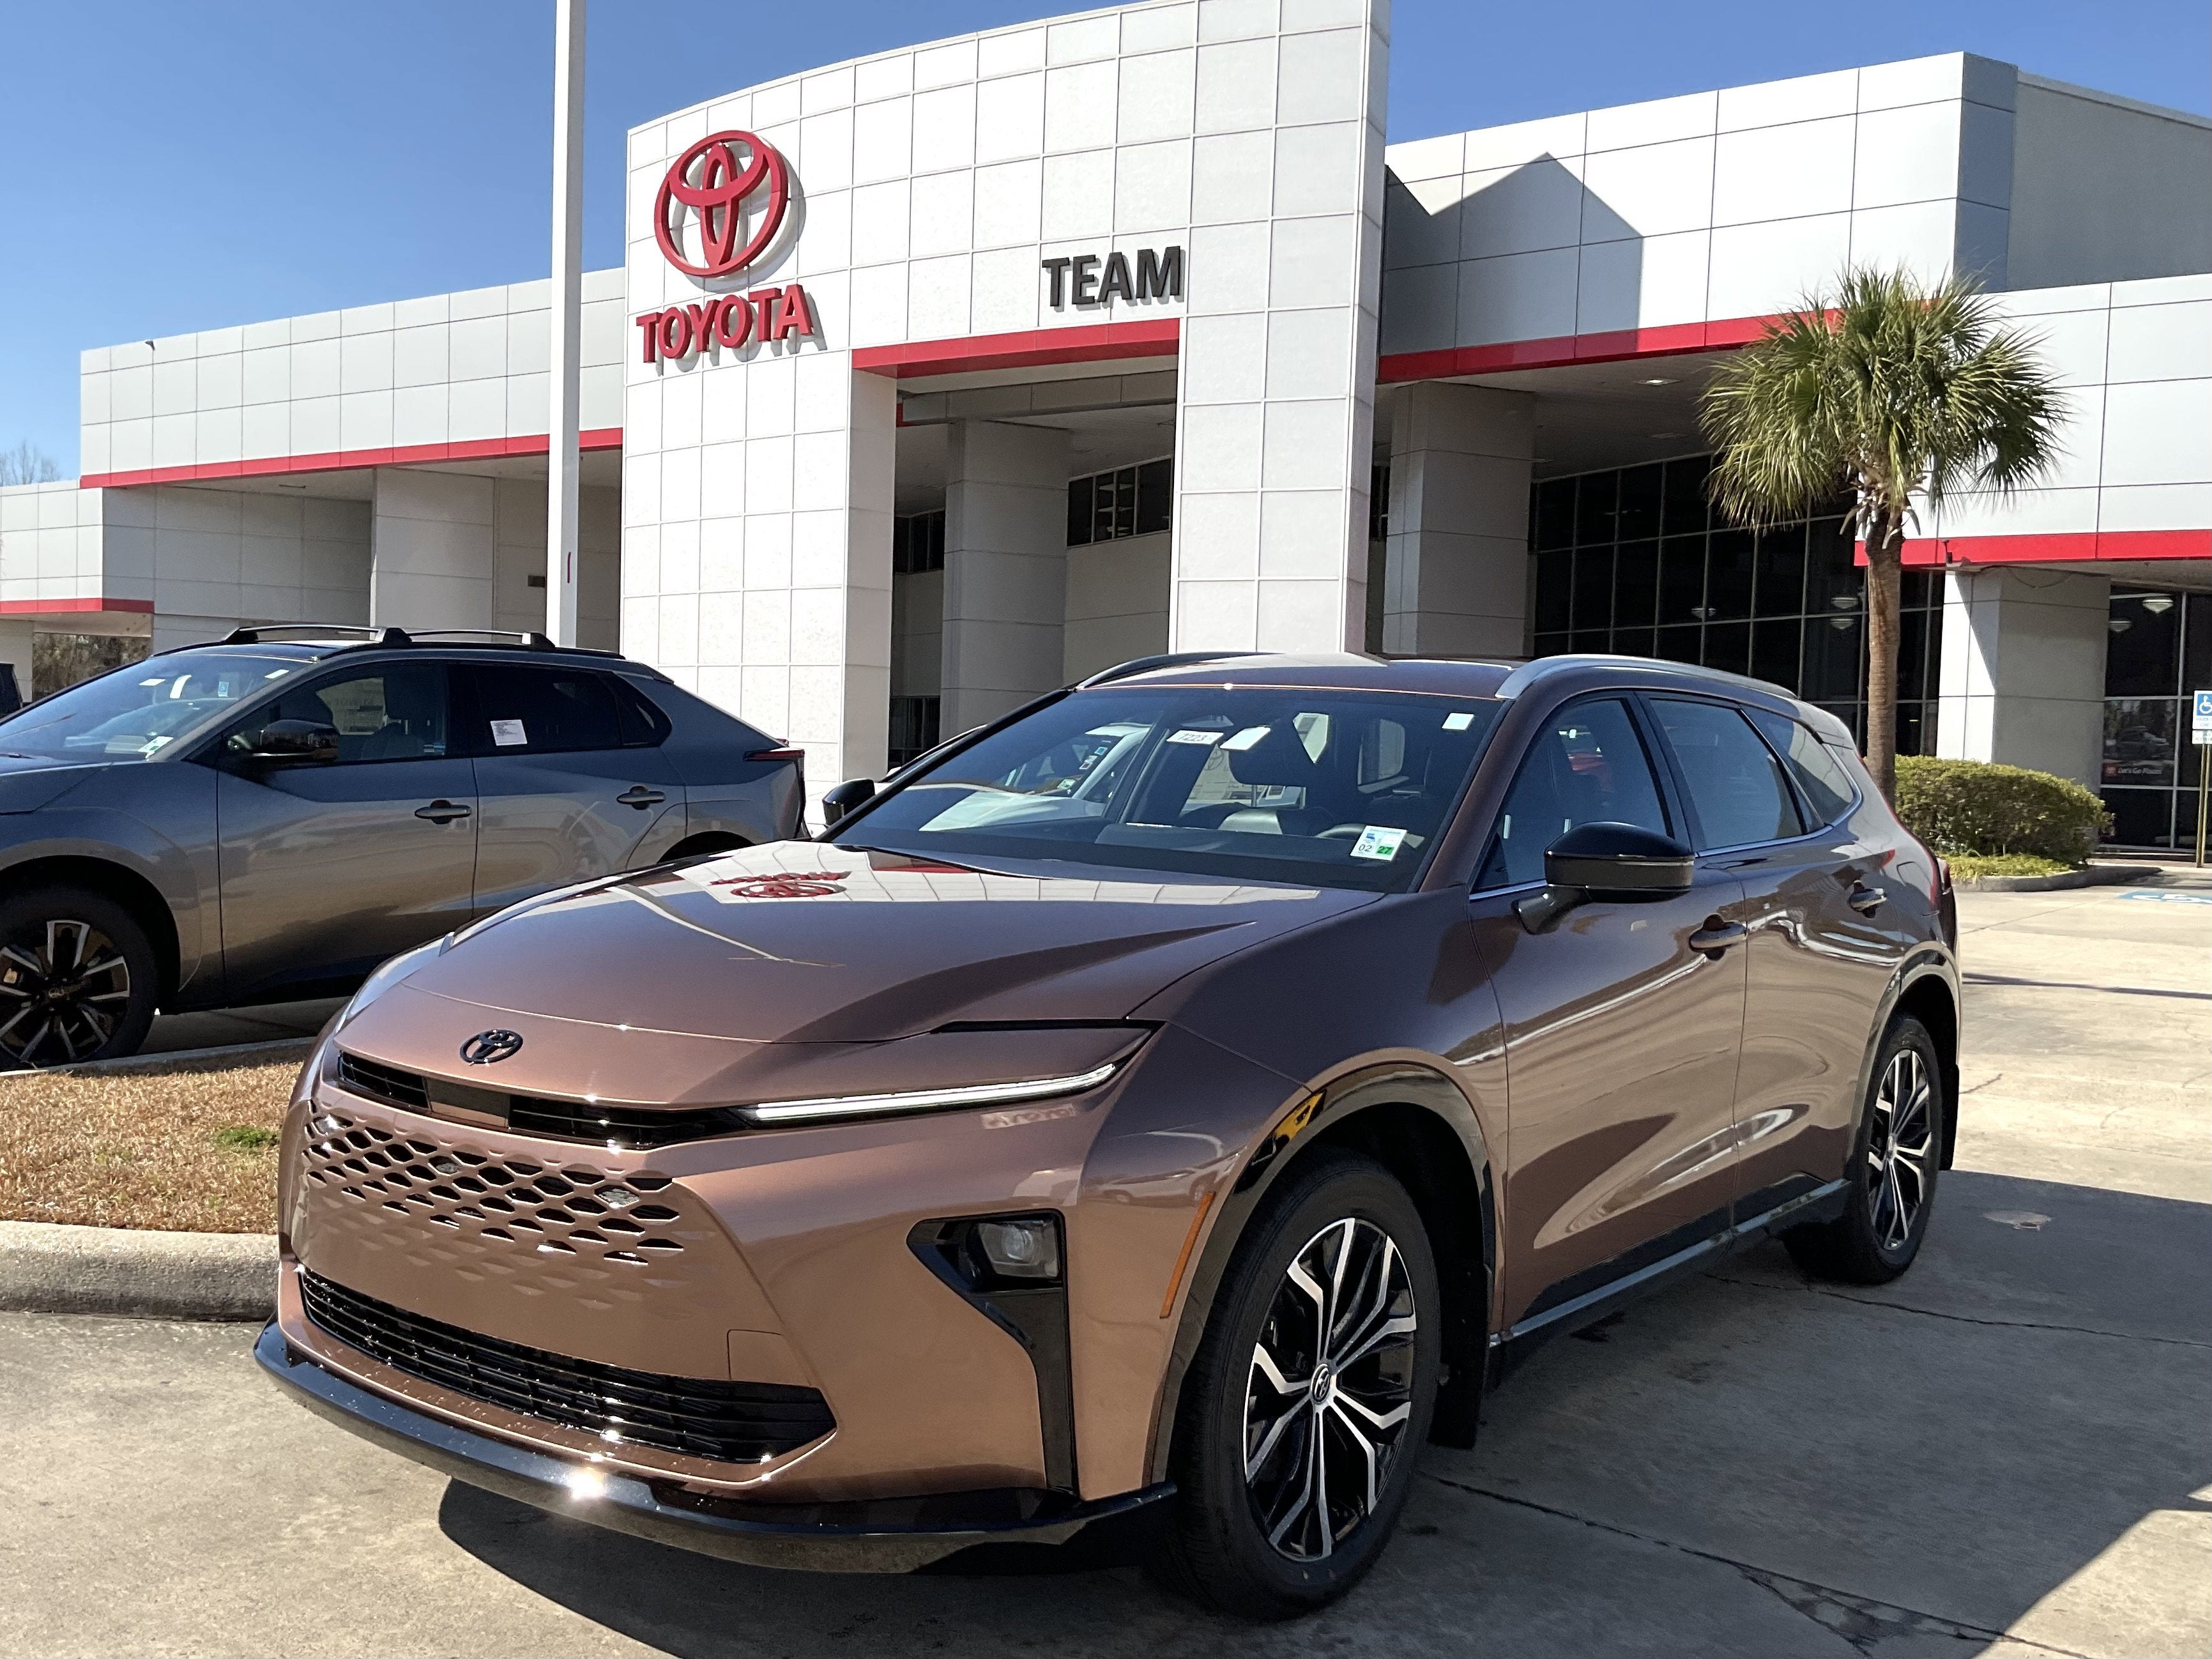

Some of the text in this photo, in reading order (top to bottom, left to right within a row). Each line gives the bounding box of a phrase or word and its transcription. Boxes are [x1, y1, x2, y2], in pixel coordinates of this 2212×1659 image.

[1042, 246, 1180, 307] TEAM
[636, 284, 813, 363] TOYOTA
[1358, 844, 1373, 852] 02
[1377, 846, 1392, 854] 27
